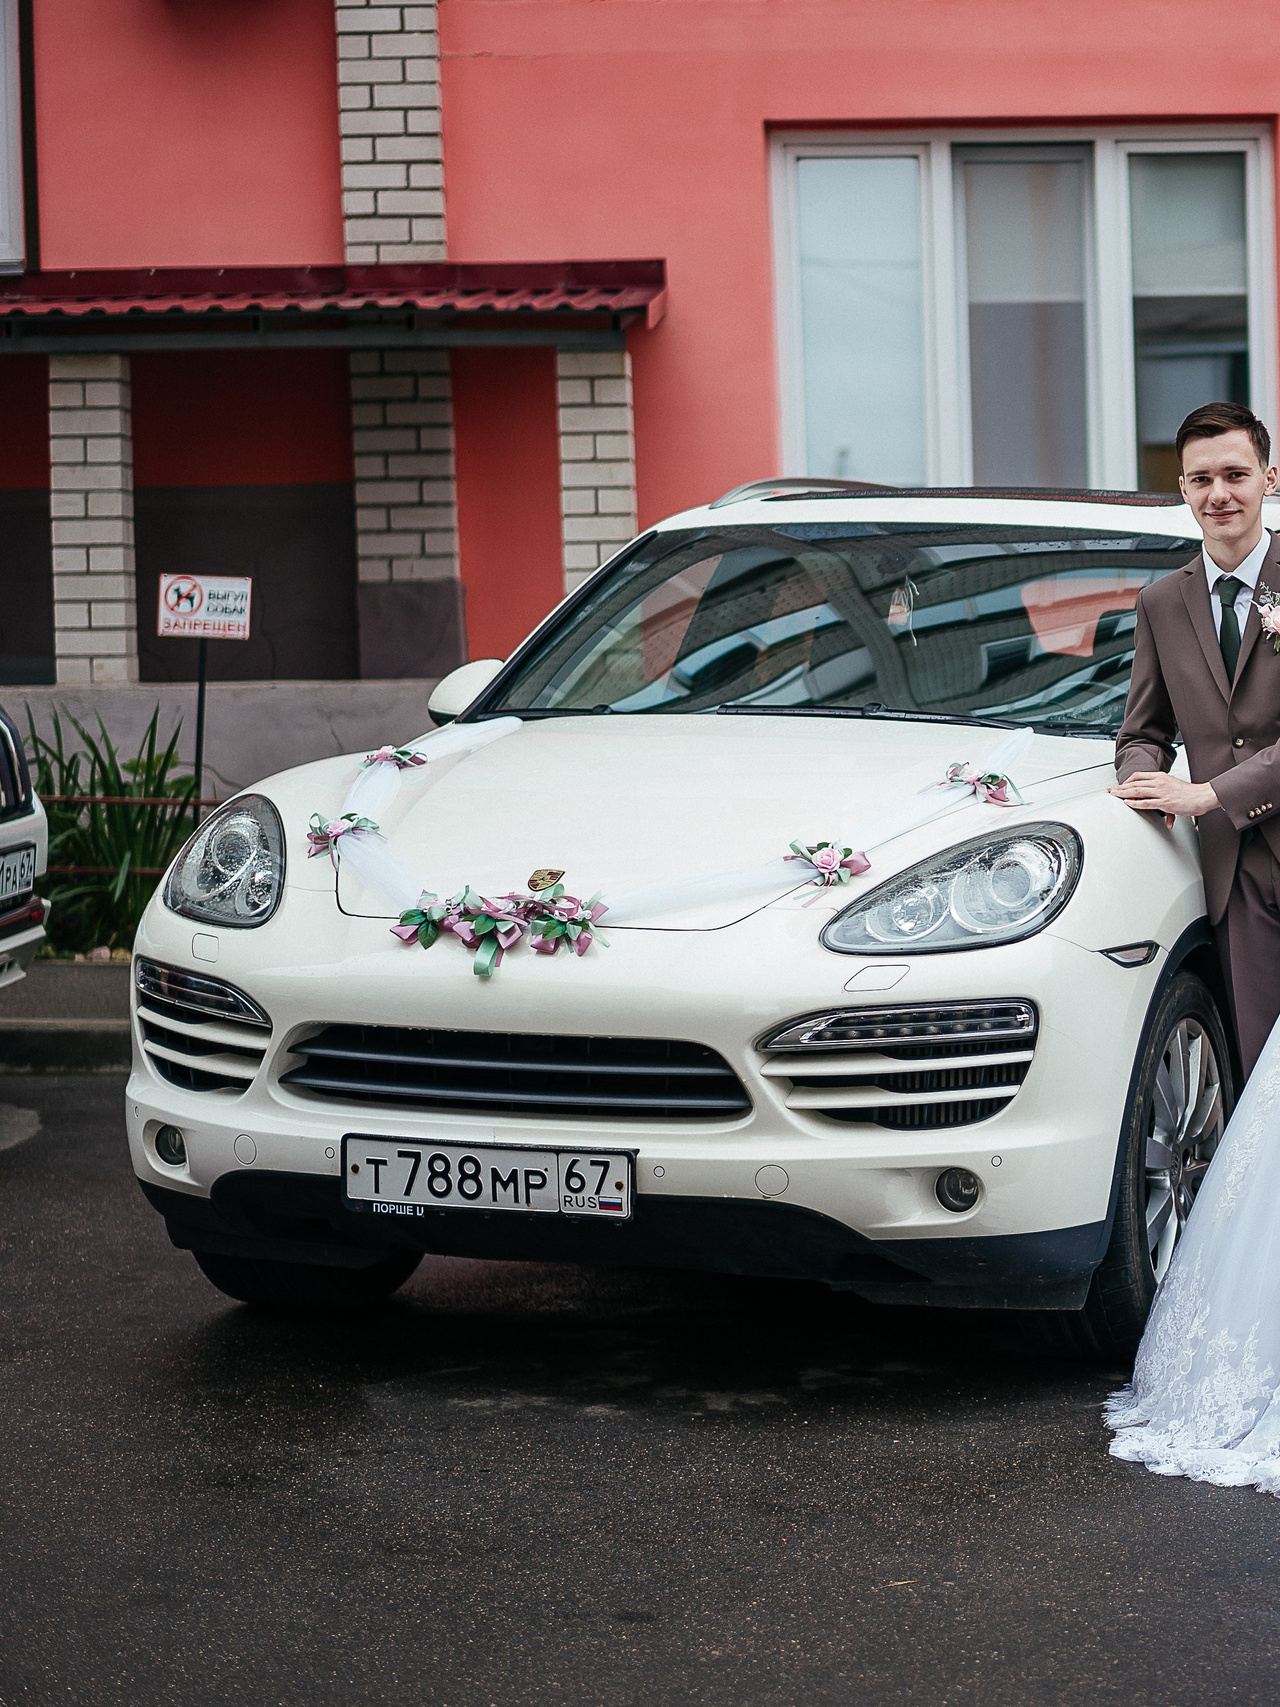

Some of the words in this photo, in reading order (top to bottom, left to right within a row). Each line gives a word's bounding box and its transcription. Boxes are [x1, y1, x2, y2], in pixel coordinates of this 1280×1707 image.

[208, 590, 248, 601] ВЫГУЛ
[207, 602, 246, 615] СОБАК
[564, 1158, 610, 1195] 67
[563, 1194, 597, 1209] RUS
[373, 1202, 414, 1216] ПОРШЕ
